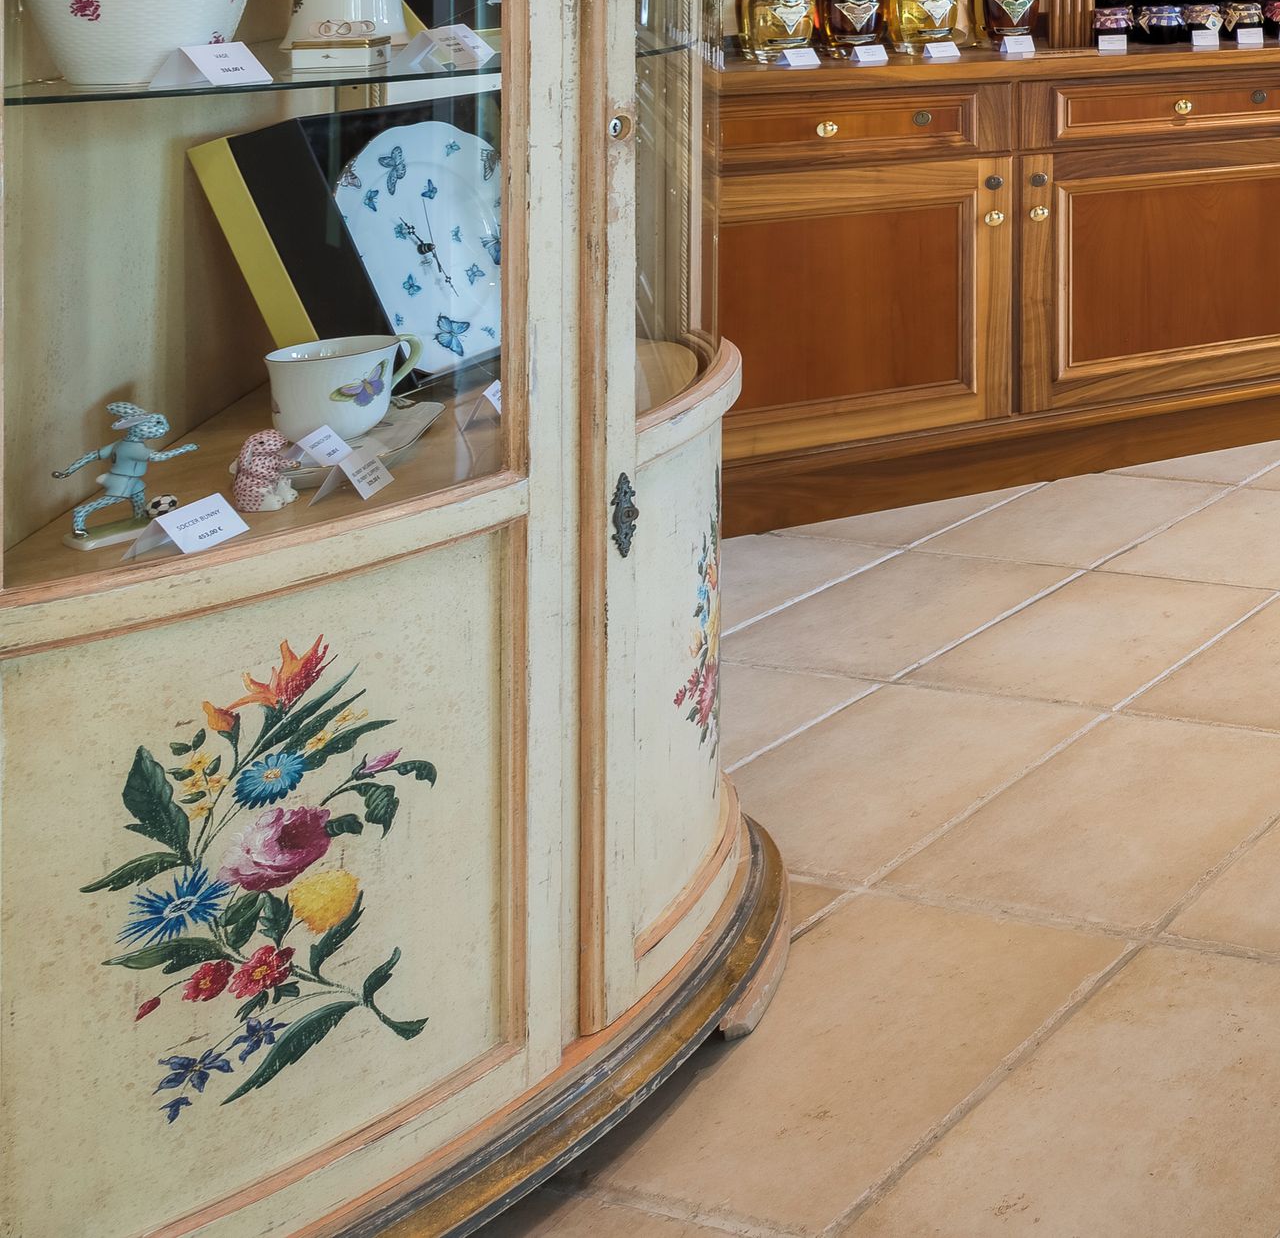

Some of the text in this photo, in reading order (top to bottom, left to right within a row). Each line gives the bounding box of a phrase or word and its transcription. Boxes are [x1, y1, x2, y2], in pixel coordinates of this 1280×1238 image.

[176, 509, 220, 531] SOCCER BUNNY
[198, 528, 218, 540] 453,00
